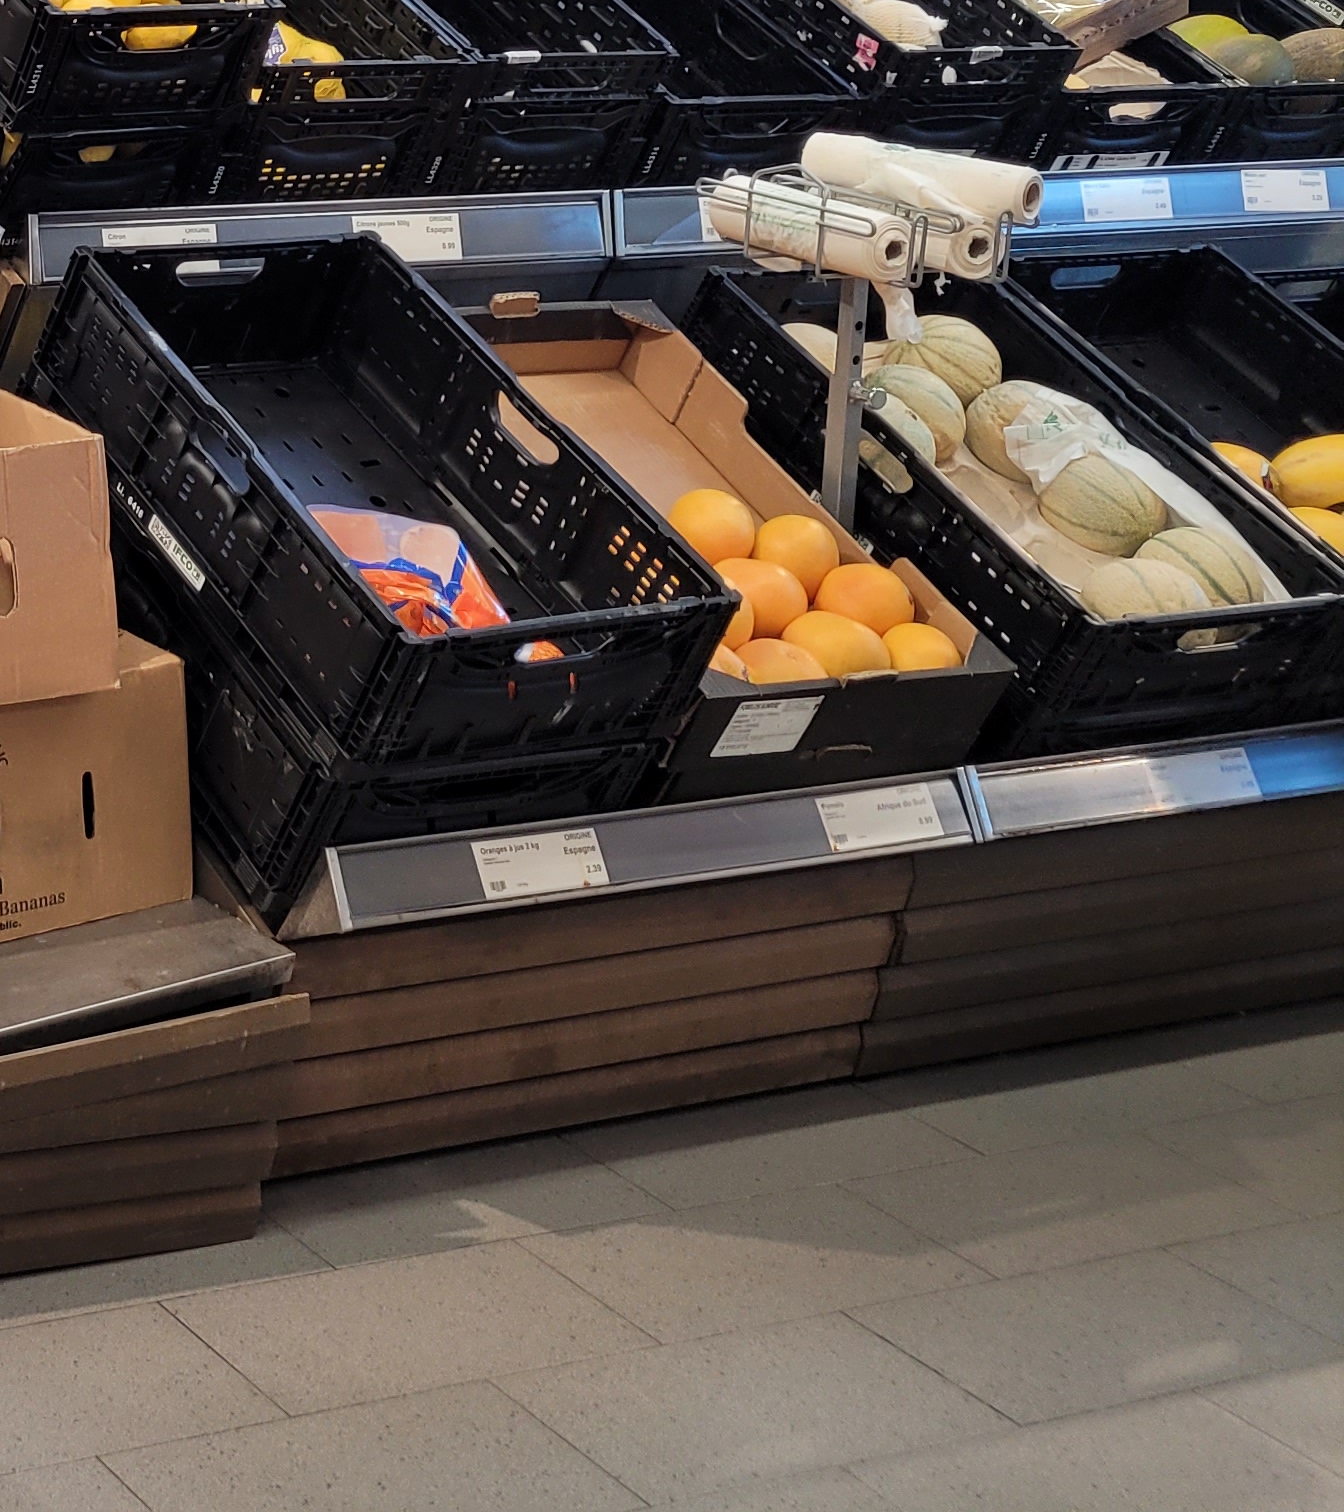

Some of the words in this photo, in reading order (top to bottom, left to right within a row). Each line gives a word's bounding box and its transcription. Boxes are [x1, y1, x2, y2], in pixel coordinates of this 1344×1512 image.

[426, 226, 454, 235] Espagne
[172, 543, 194, 571] IFCO
[877, 801, 902, 811] Afrique
[564, 831, 592, 841] ORIGINE
[480, 846, 508, 856] Oranges
[514, 844, 524, 853] jus
[530, 842, 540, 851] kg
[563, 844, 596, 856] Espagne
[585, 864, 602, 874] 2.39
